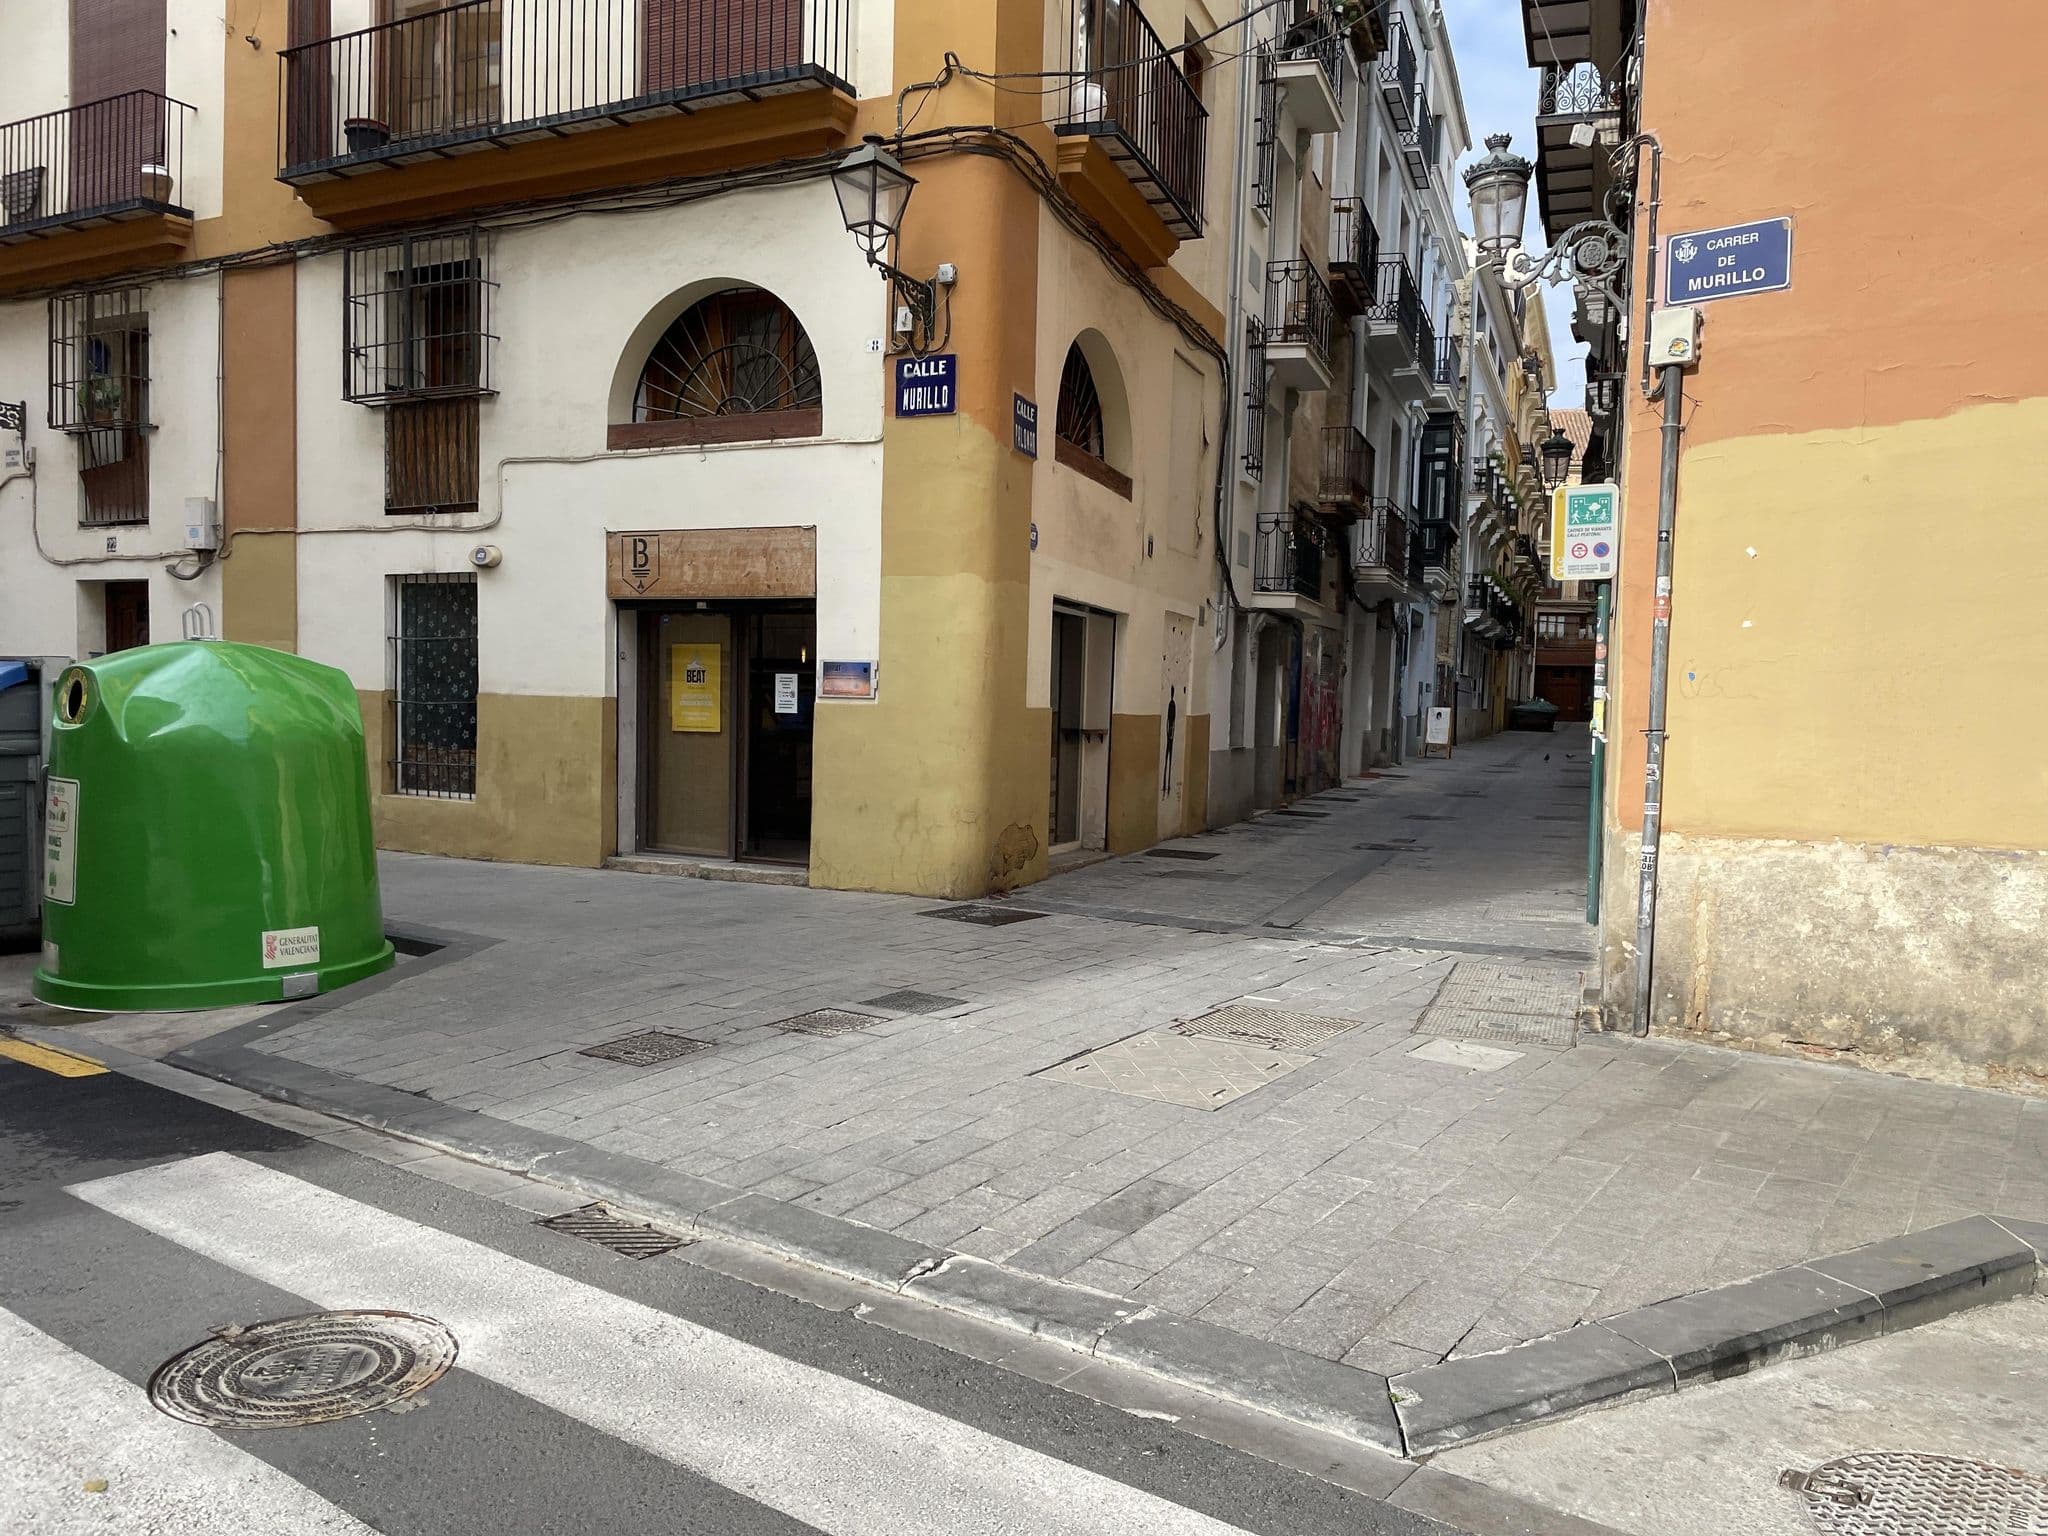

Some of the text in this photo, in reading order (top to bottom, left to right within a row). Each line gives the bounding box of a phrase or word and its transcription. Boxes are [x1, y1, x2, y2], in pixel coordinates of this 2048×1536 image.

[1706, 232, 1759, 251] CARRER
[1717, 254, 1736, 267] DE
[1688, 267, 1766, 292] MURILLO
[903, 360, 947, 379] CALLE
[902, 385, 948, 411] MURILLO
[1016, 399, 1035, 423] CALLE
[632, 538, 649, 568] B
[686, 669, 706, 684] BEAT
[279, 934, 318, 946] GENERALITAT
[279, 944, 319, 956] VALENCIANA
